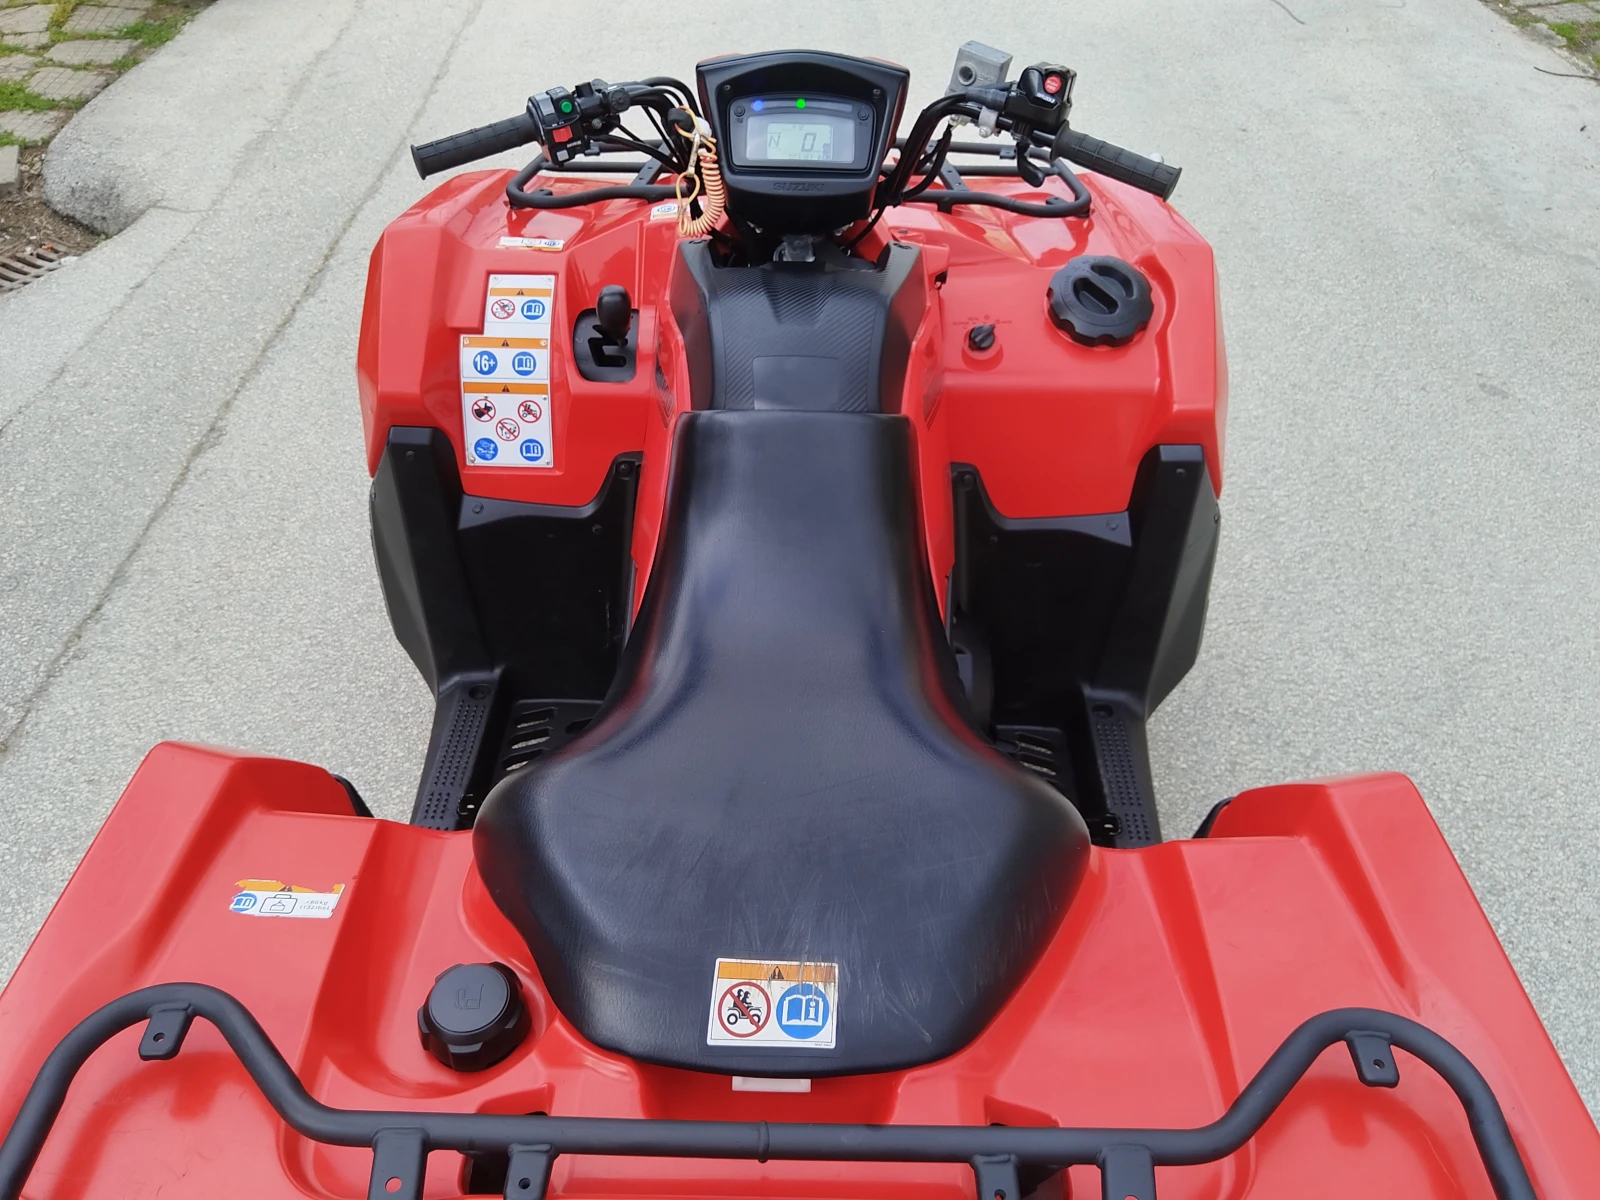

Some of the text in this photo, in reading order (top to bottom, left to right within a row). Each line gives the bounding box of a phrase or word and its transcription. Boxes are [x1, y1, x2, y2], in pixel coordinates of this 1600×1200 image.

[801, 132, 818, 152] 0
[773, 182, 825, 193] SUZUKI
[474, 354, 496, 372] 16+
